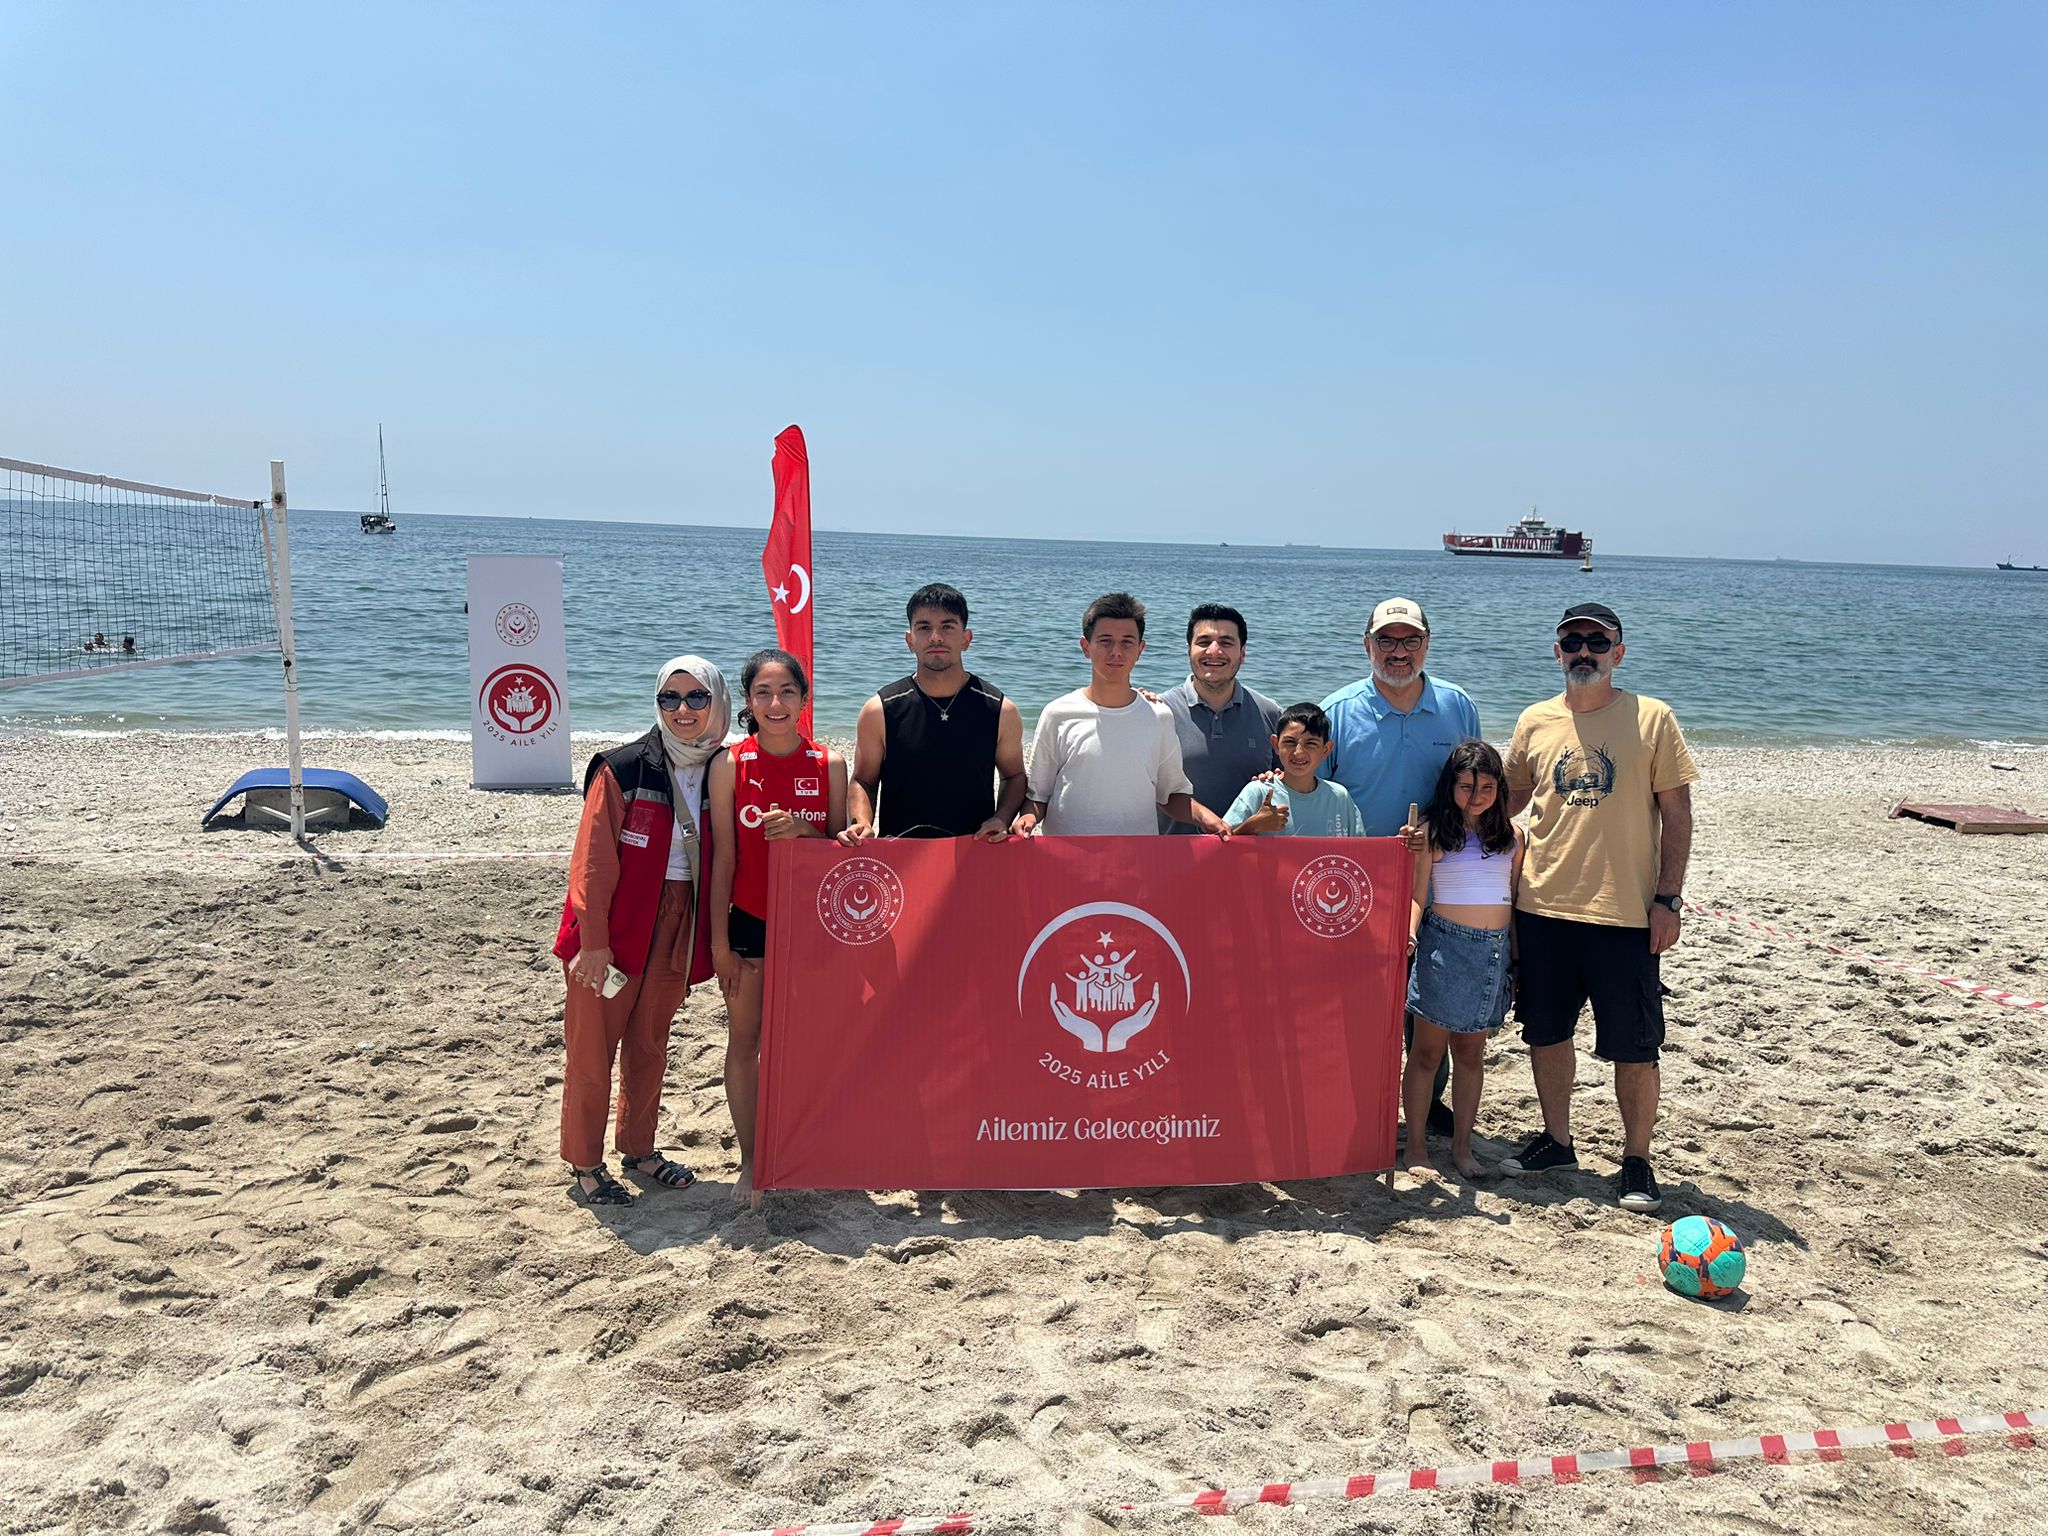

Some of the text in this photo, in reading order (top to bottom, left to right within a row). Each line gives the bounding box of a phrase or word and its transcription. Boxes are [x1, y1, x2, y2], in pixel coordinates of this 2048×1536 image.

[482, 720, 506, 742] 2025
[540, 721, 559, 740] YILI
[1566, 795, 1599, 809] Jeep
[788, 808, 827, 821] afone
[1038, 1049, 1171, 1089] 2025 AİLE YILI
[976, 1113, 1221, 1145] Ailemiz Geleceğimiz
